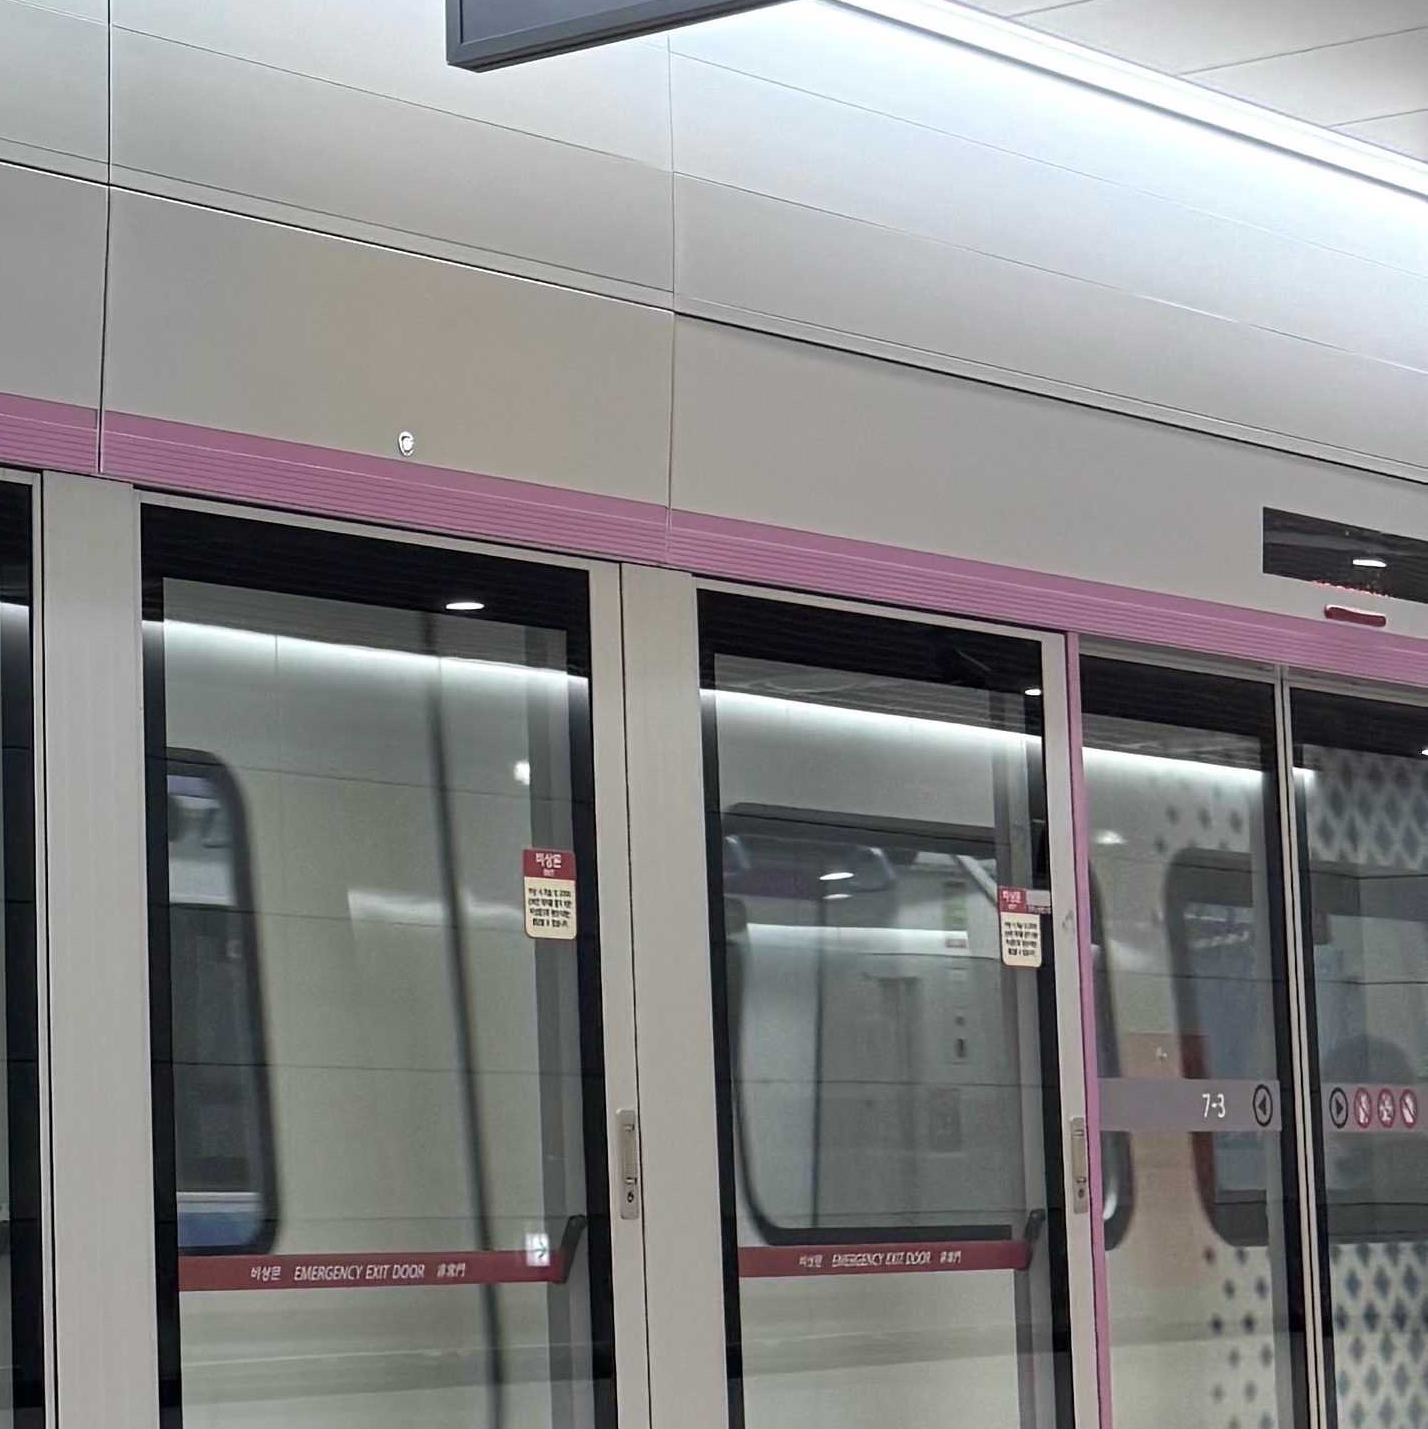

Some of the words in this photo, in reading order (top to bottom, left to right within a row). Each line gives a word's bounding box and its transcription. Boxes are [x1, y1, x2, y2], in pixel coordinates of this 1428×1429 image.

[1202, 1093, 1226, 1119] 7-3
[294, 1265, 363, 1281] EMERGENCY
[365, 1264, 391, 1280] EXIT
[392, 1264, 426, 1279] DOOR
